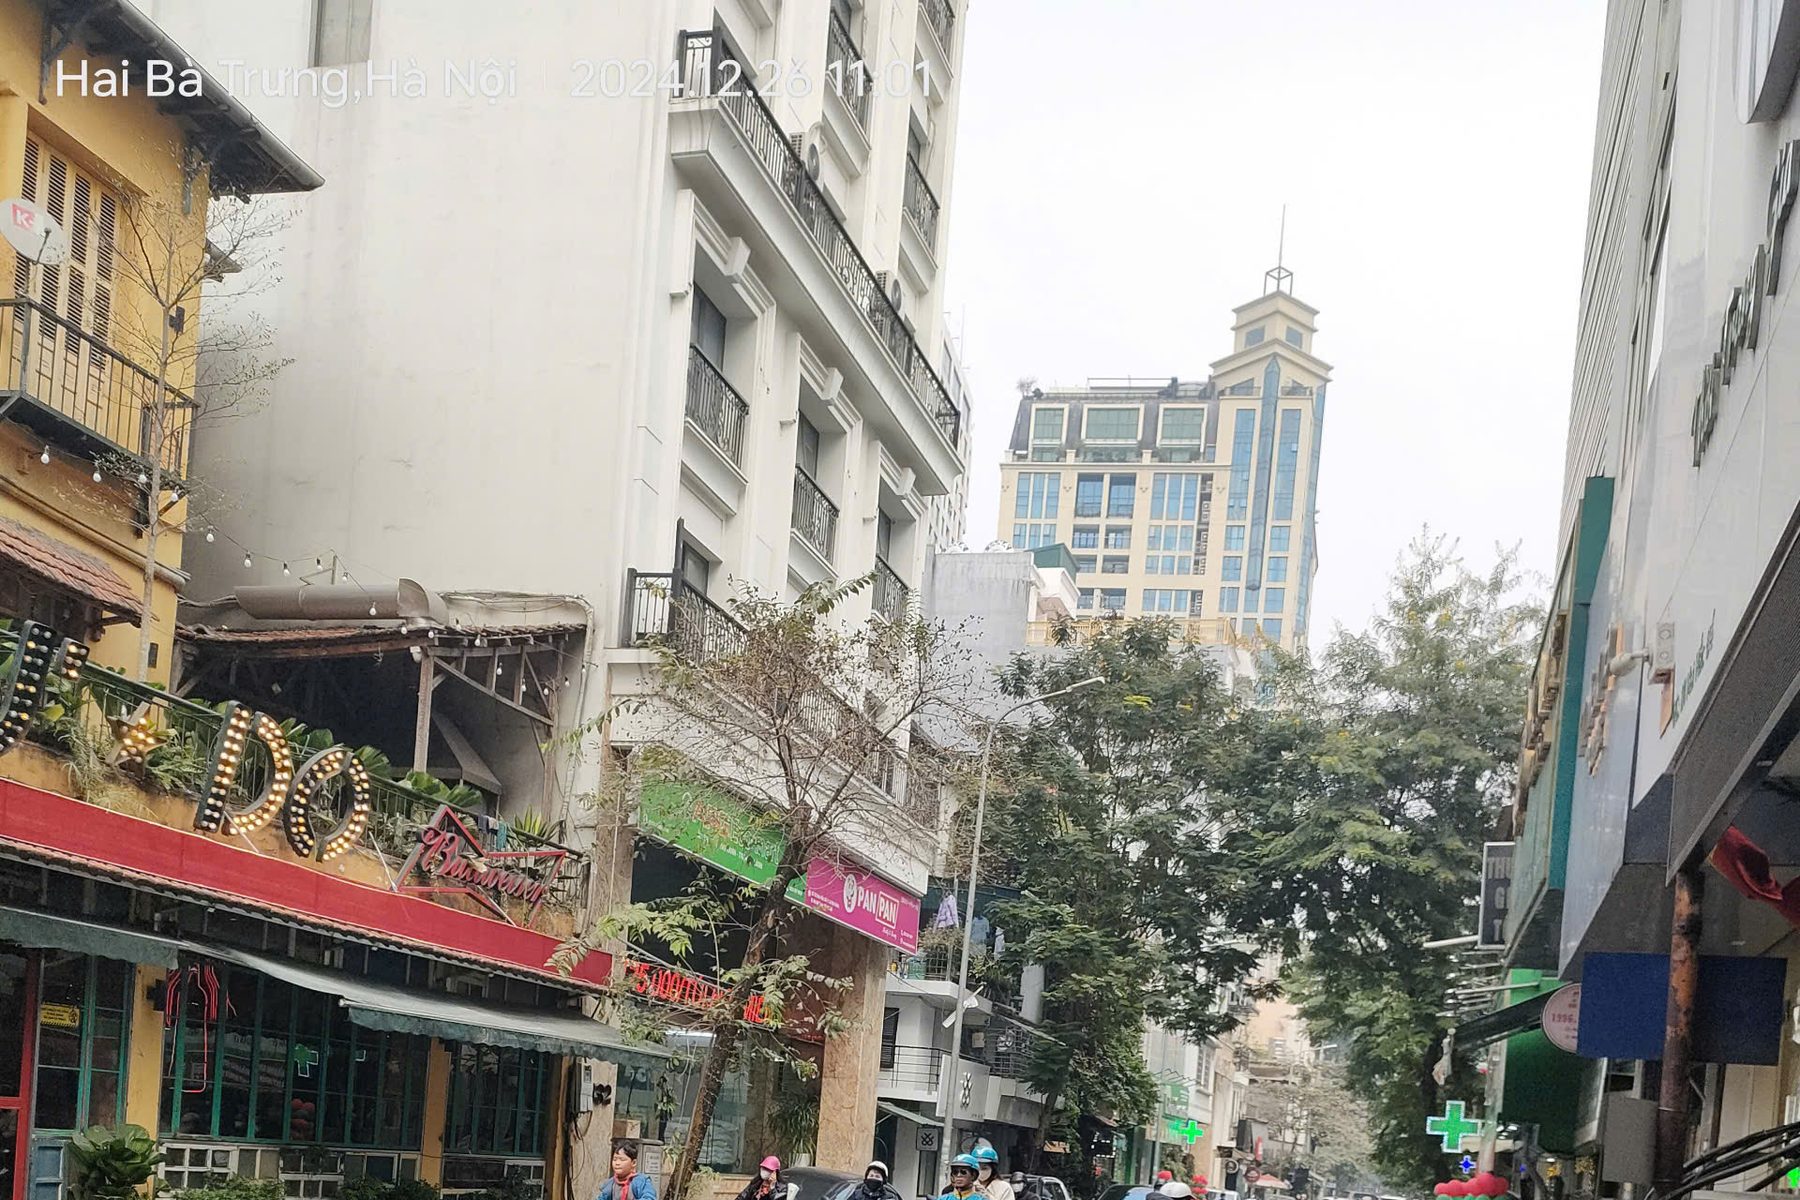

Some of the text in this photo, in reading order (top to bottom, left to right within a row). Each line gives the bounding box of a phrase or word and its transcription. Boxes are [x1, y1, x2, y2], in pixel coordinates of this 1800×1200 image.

[193, 700, 371, 862] DO
[857, 886, 877, 914] PAN
[878, 896, 898, 924] PAN
